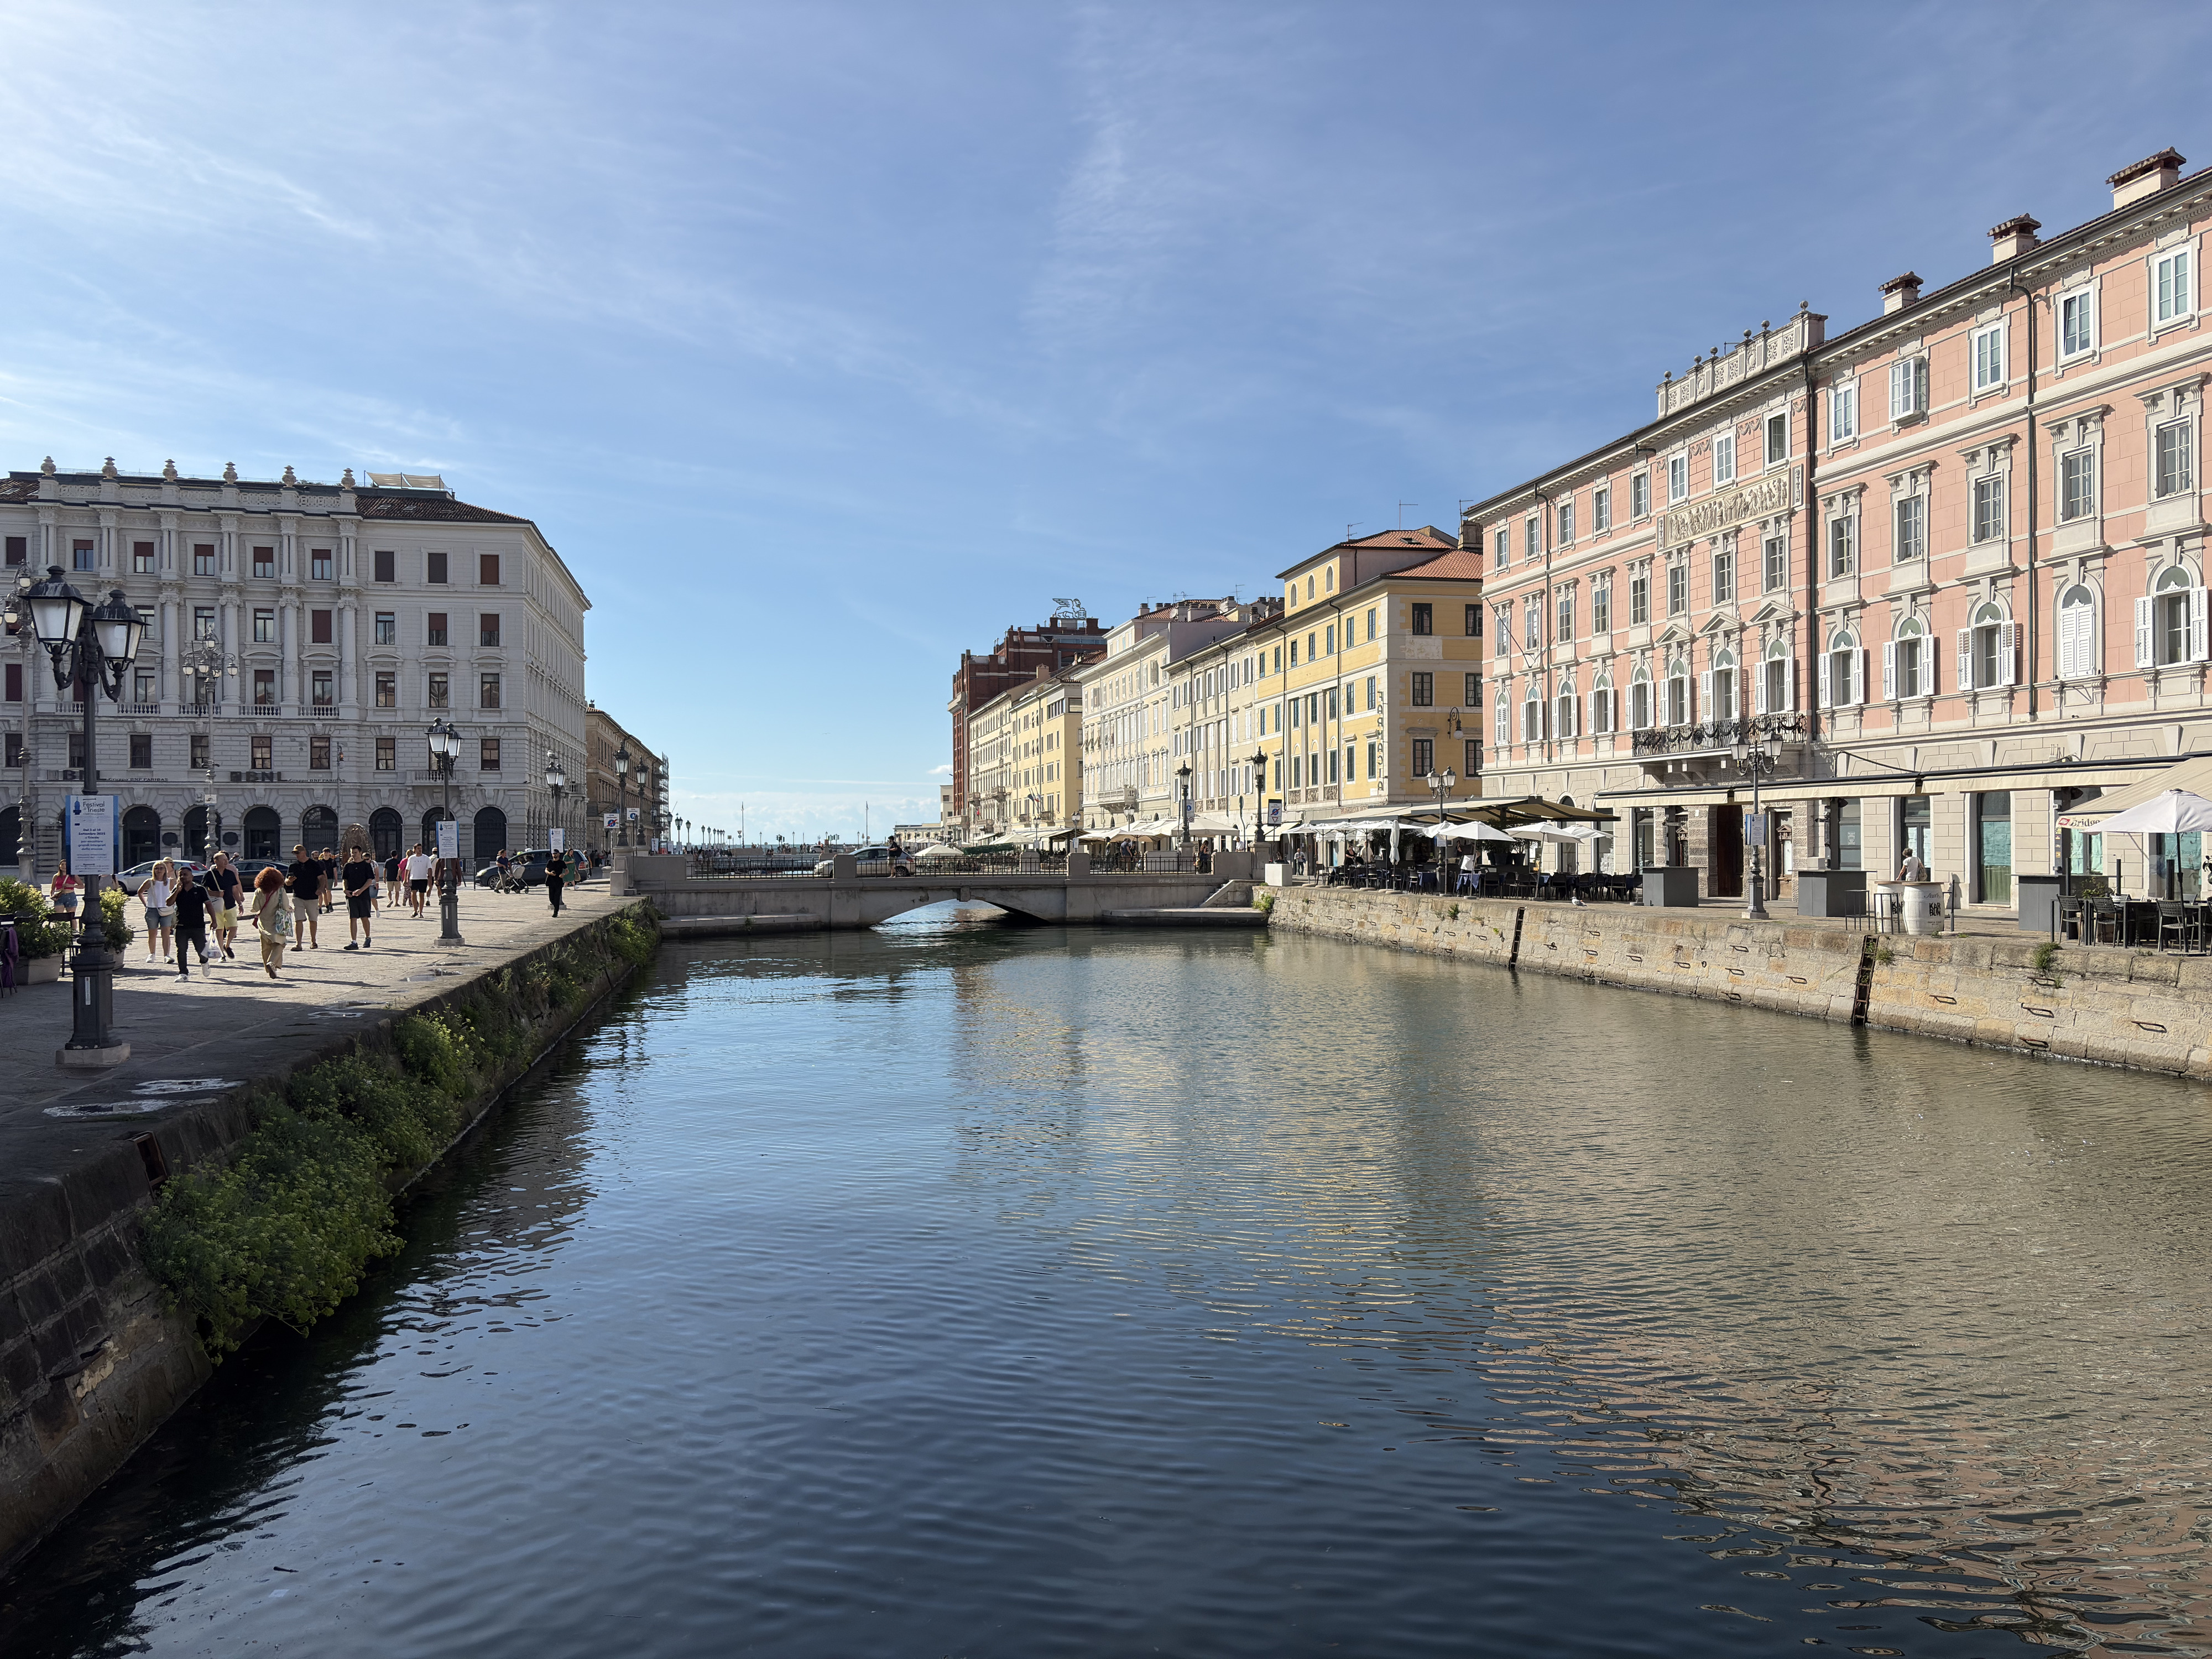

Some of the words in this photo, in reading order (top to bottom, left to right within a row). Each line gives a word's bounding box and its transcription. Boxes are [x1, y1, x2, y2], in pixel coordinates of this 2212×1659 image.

[63, 770, 107, 780] BL
[246, 771, 288, 782] BNL
[2069, 818, 2100, 827] Bridge
